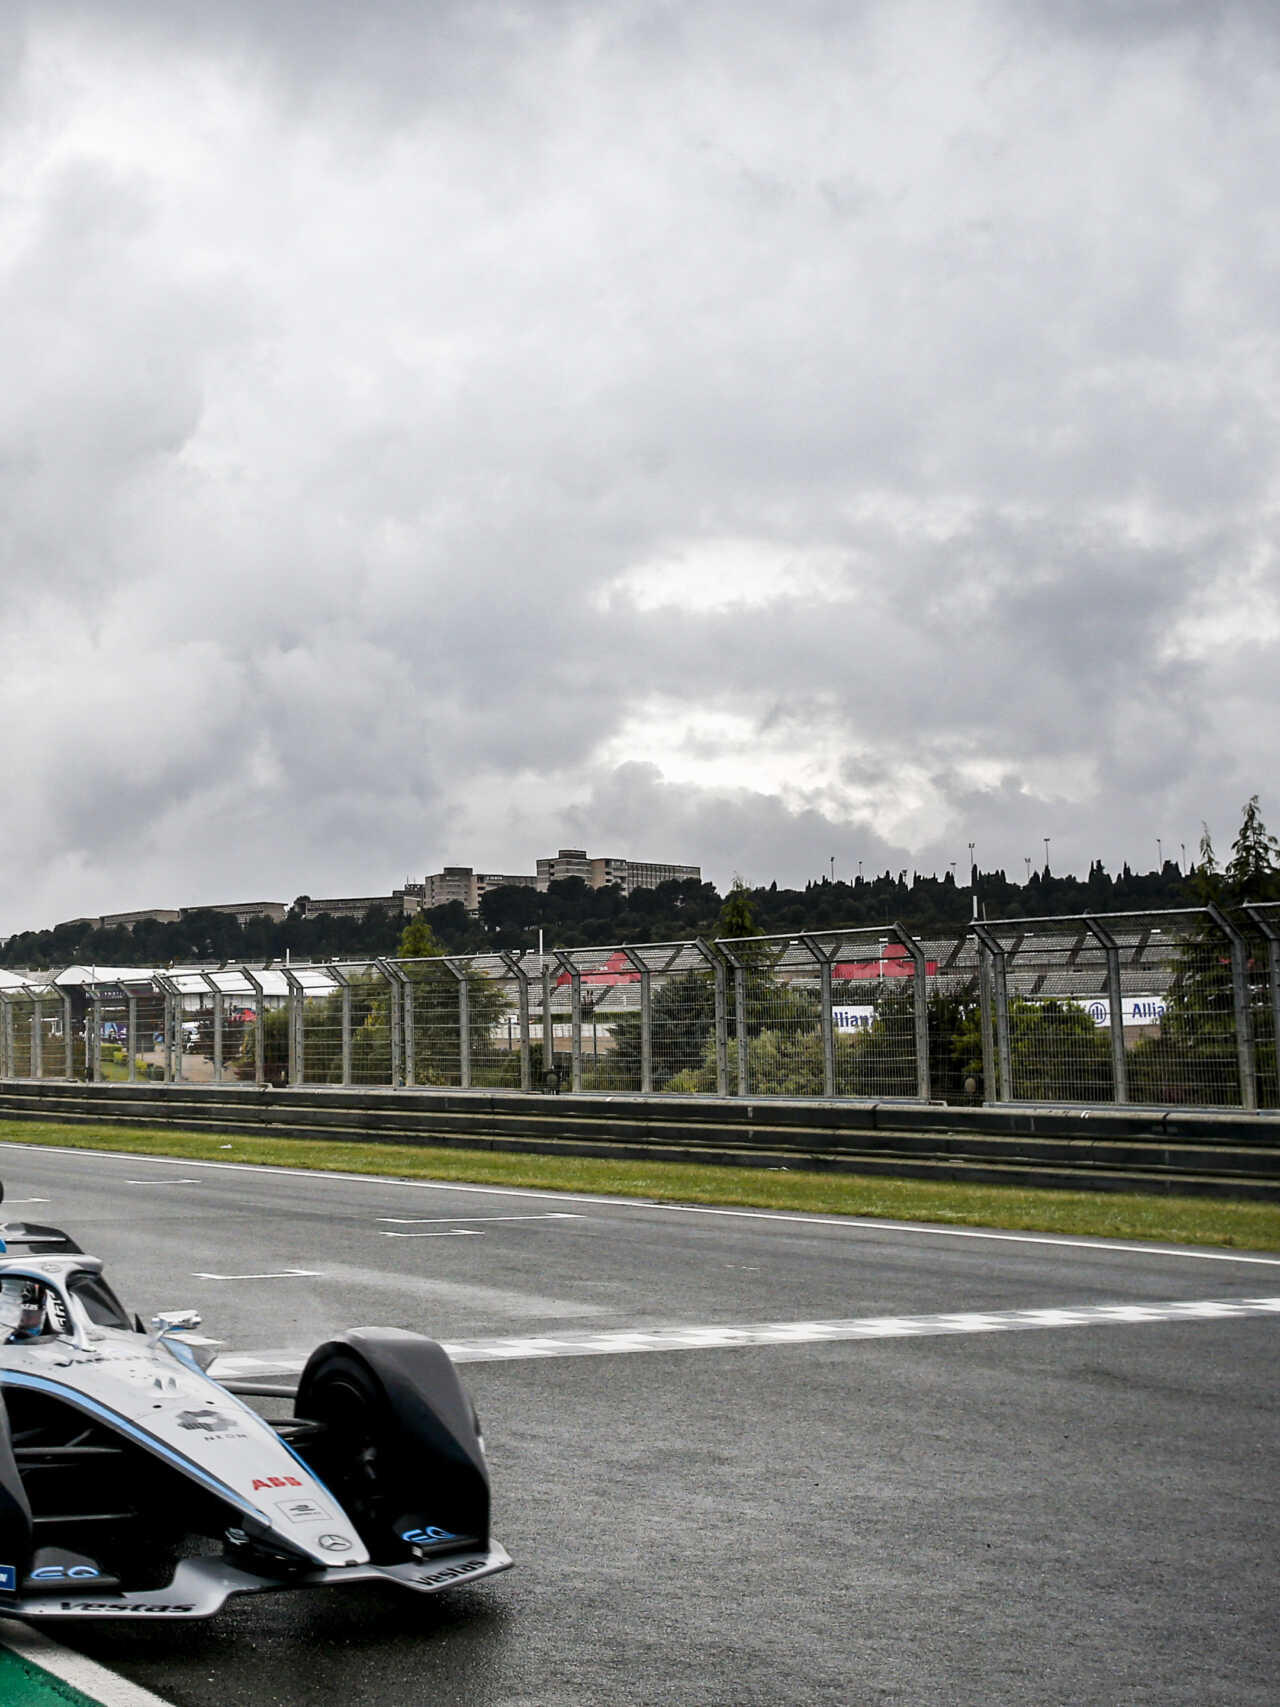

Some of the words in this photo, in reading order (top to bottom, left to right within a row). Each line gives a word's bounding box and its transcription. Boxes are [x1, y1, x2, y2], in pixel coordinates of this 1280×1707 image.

[252, 1476, 303, 1491] ABB
[416, 1560, 487, 1586] Vestas
[60, 1601, 196, 1613] Vestas
